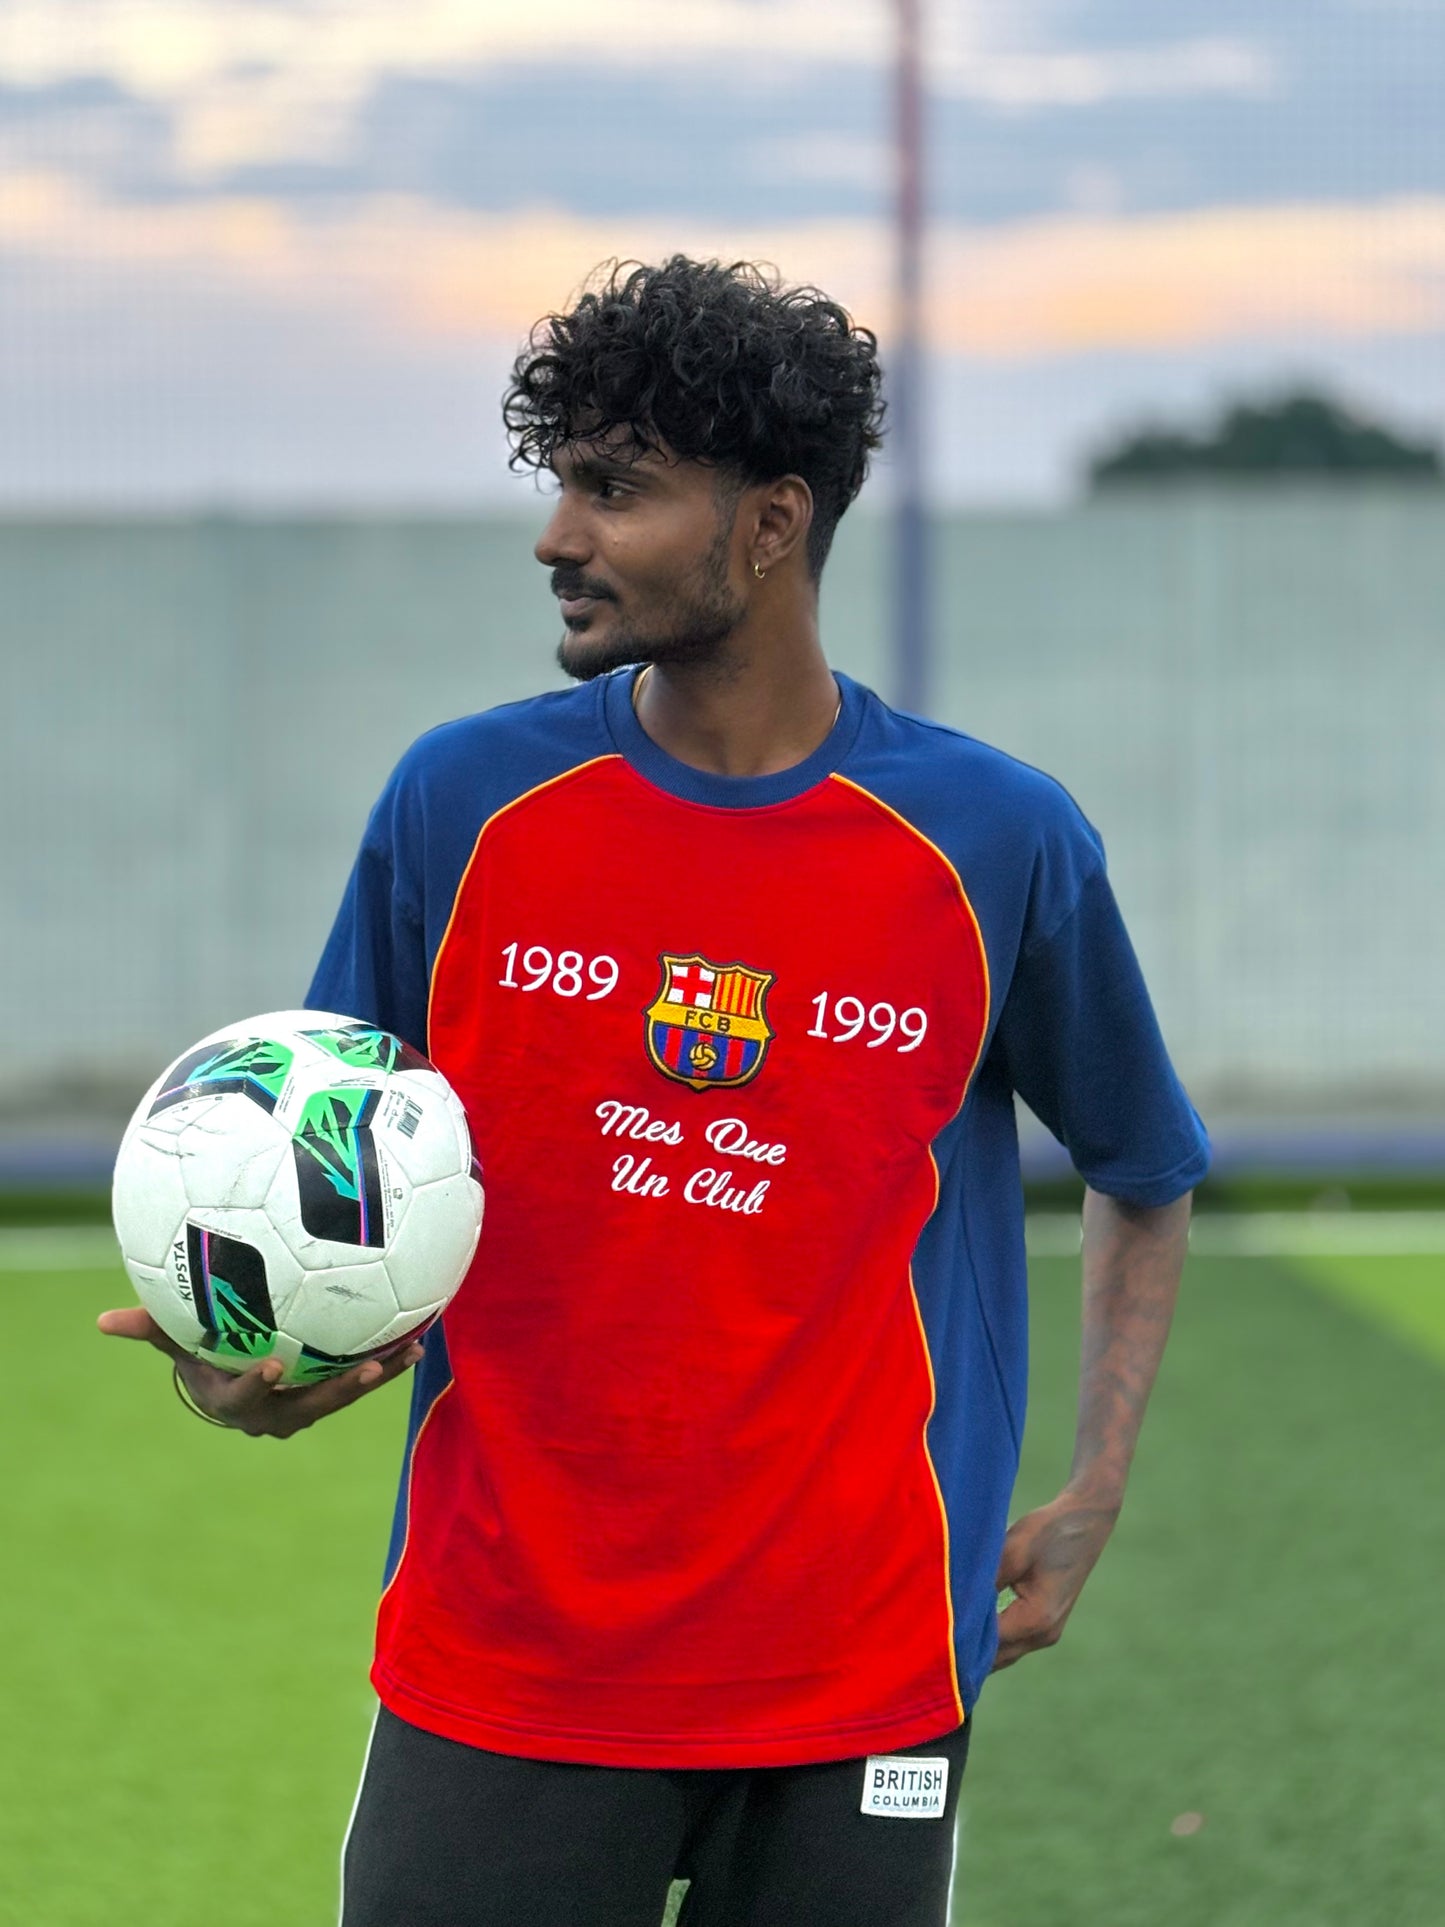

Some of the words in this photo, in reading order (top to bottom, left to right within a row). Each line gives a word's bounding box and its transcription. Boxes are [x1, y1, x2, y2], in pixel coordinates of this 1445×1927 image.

[498, 942, 619, 1001] 1989
[684, 1010, 731, 1033] FCB
[807, 991, 928, 1053] 1999
[595, 1100, 684, 1146] Mes
[705, 1118, 787, 1166] Que
[611, 1154, 670, 1198] Un
[683, 1167, 771, 1215] Club
[173, 1240, 193, 1302] KIPSTA
[872, 1794, 940, 1808] COLUMBIA
[873, 1768, 943, 1791] BRITISH
